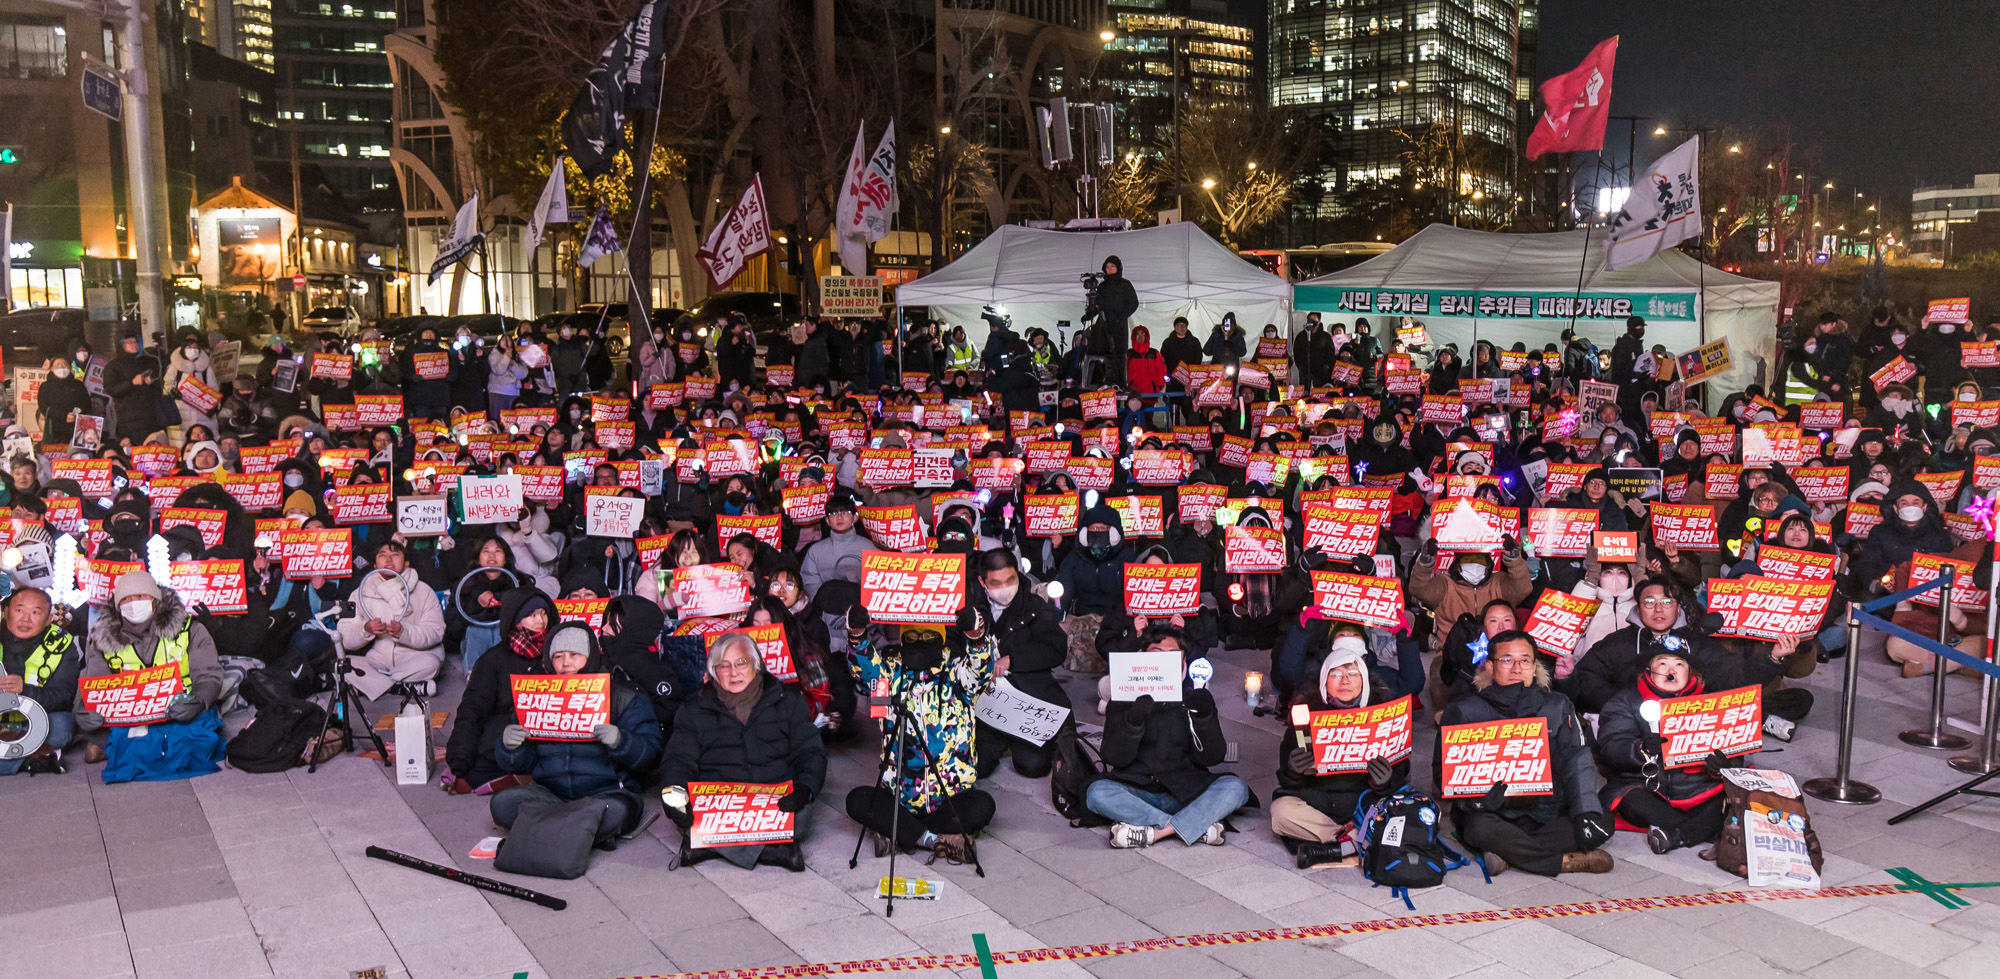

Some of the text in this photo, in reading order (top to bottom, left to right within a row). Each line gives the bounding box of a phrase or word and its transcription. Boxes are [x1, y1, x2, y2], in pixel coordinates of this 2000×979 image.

[1338, 291, 1633, 318] 시민 휴게실 잠시 추위를 피해가세요
[862, 459, 912, 468] 헌재는 즉각
[914, 457, 952, 468] 김건희
[1135, 459, 1181, 468] 헌재는 즉각
[864, 469, 912, 480] 파면하라!
[1137, 469, 1182, 479] 파면하라!
[593, 499, 633, 520] 윤석열
[1026, 497, 1077, 506] 내란수괴 윤석열
[1652, 504, 1711, 516] 내란수괴 윤석열
[1027, 506, 1076, 518] 헌재는 즉각
[1309, 508, 1378, 524] 내란수괴 윤석열
[1029, 517, 1076, 530] 파면하라!
[1307, 518, 1376, 536] 헌재는 즉각
[1654, 514, 1712, 528] 헌재는 즉각
[284, 531, 348, 543] 내란수괴 윤석열
[1306, 532, 1375, 551] 파면하라!
[1603, 537, 1628, 546] 윤석열
[1657, 527, 1715, 542] 파면하라!
[285, 542, 348, 557] 헌재는 즉각
[288, 556, 349, 572] 파면하라!
[864, 555, 961, 571] 내란수괴 윤석열
[864, 570, 961, 590] 헌재는 즉각
[1127, 566, 1198, 578] 내란수괴 윤석열
[1127, 578, 1197, 593] 헌재는 즉각
[1314, 574, 1397, 590] 내란수괴 윤석열
[1745, 579, 1830, 597] 내란수괴 윤석열
[866, 590, 962, 612] 파면하라!
[1130, 592, 1197, 609] 파면하라!
[1315, 585, 1398, 604] 헌재는 즉각
[1318, 599, 1400, 619] 파면하라!
[1742, 593, 1827, 614] 헌재는 즉각
[1743, 611, 1823, 632] 파면하라!
[84, 666, 175, 690] 내란수괴 윤석열
[515, 678, 605, 692] 내란수괴 윤석열
[86, 678, 177, 703] 헌재는 즉각
[518, 693, 605, 710] 헌재는 즉각
[1664, 689, 1757, 718] 내란수괴 윤석열
[523, 712, 606, 730] 파면하라!
[1314, 699, 1407, 728] 내란수괴 윤석열
[1665, 704, 1758, 737] 헌재는 즉각
[1316, 713, 1407, 746] 헌재는 즉각
[1444, 722, 1542, 744] 내란수괴 윤석열
[1321, 730, 1408, 764] 파면하라!
[1669, 722, 1759, 757] 파면하라!
[1444, 738, 1543, 764] 헌재는 즉각
[1448, 758, 1546, 785] 파면하라!
[692, 784, 788, 799] 내란수괴 윤석열
[692, 800, 748, 817] 헌재는
[696, 814, 790, 836] 파면하라!
